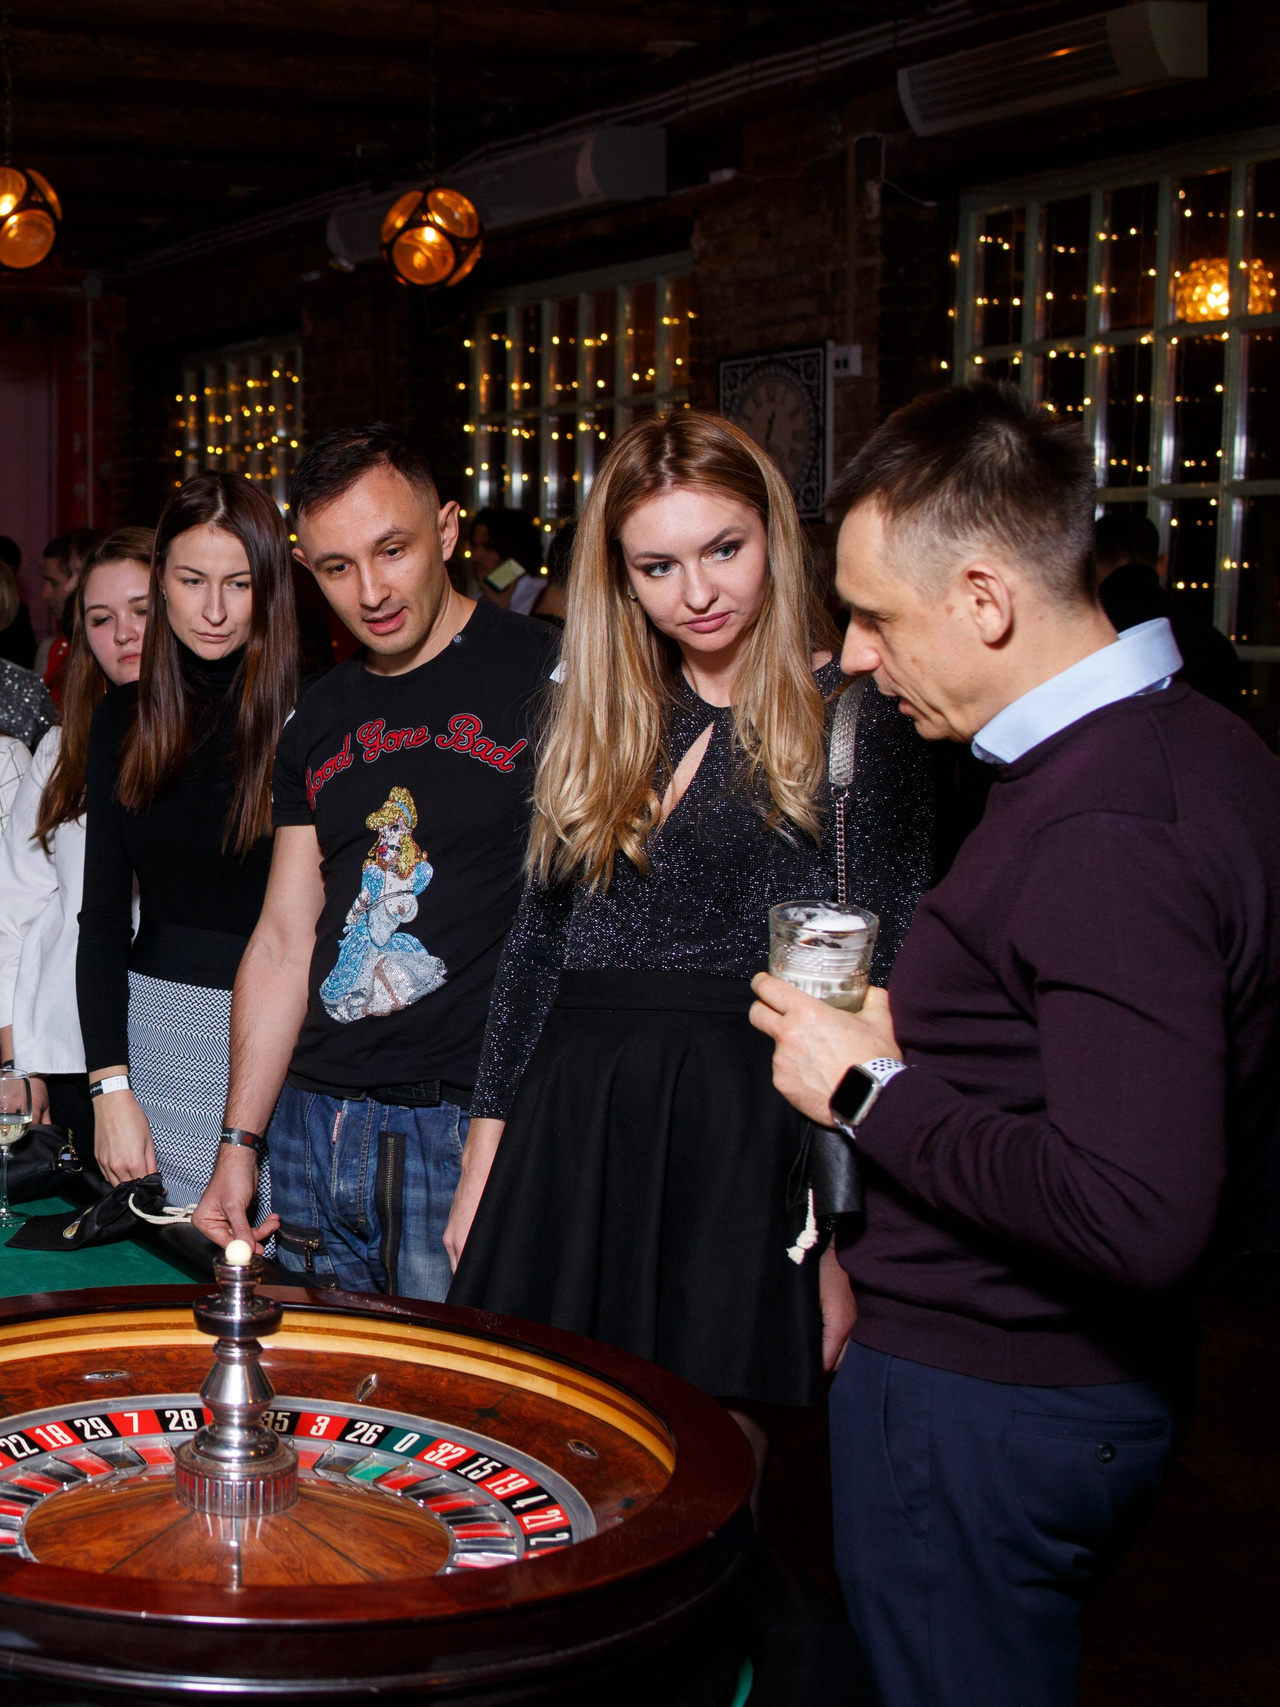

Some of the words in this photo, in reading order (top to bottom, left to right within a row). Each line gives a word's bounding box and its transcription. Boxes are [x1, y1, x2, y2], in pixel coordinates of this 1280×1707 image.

[356, 717, 431, 764] Gone
[434, 712, 528, 774] Bad
[73, 1416, 112, 1440] 29
[123, 1412, 139, 1433] 7
[165, 1409, 197, 1431] 28
[260, 1411, 291, 1432] 35
[310, 1415, 331, 1436] 3
[35, 1424, 73, 1448] 18
[344, 1421, 384, 1445] 26
[393, 1432, 420, 1453] 0
[423, 1442, 468, 1467] 32
[456, 1457, 502, 1480] 15
[485, 1473, 529, 1496] 19
[512, 1494, 548, 1509] 4
[522, 1509, 564, 1530] 21
[529, 1532, 570, 1546] 2
